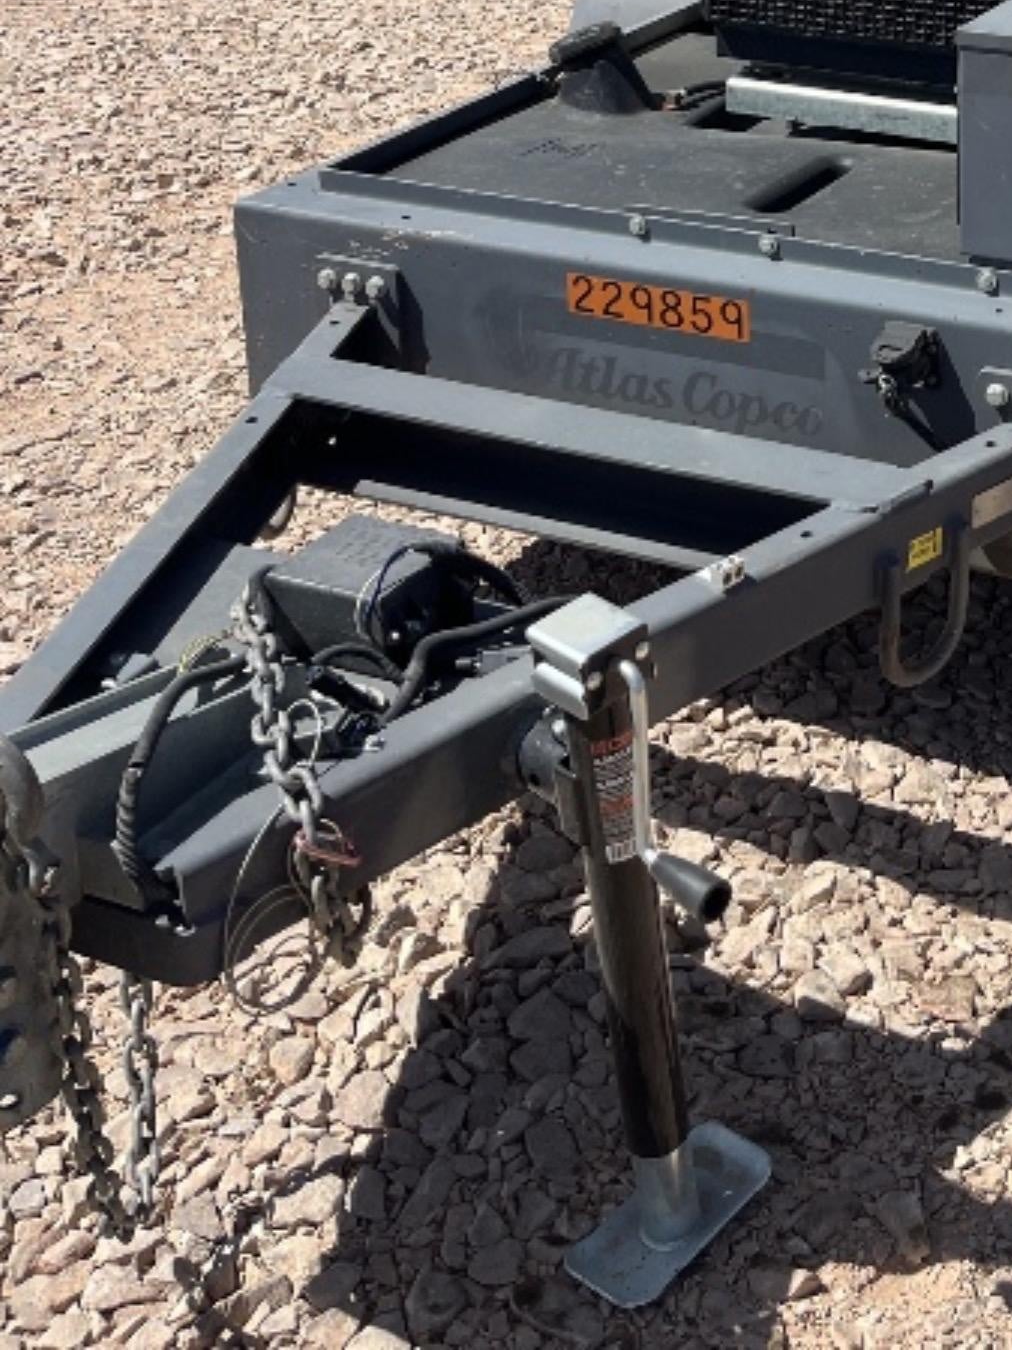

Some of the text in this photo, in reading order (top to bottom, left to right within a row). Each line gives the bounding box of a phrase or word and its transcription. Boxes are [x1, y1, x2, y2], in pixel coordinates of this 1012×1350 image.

[571, 275, 743, 339] 229859
[547, 347, 822, 436] Atlas Copco
